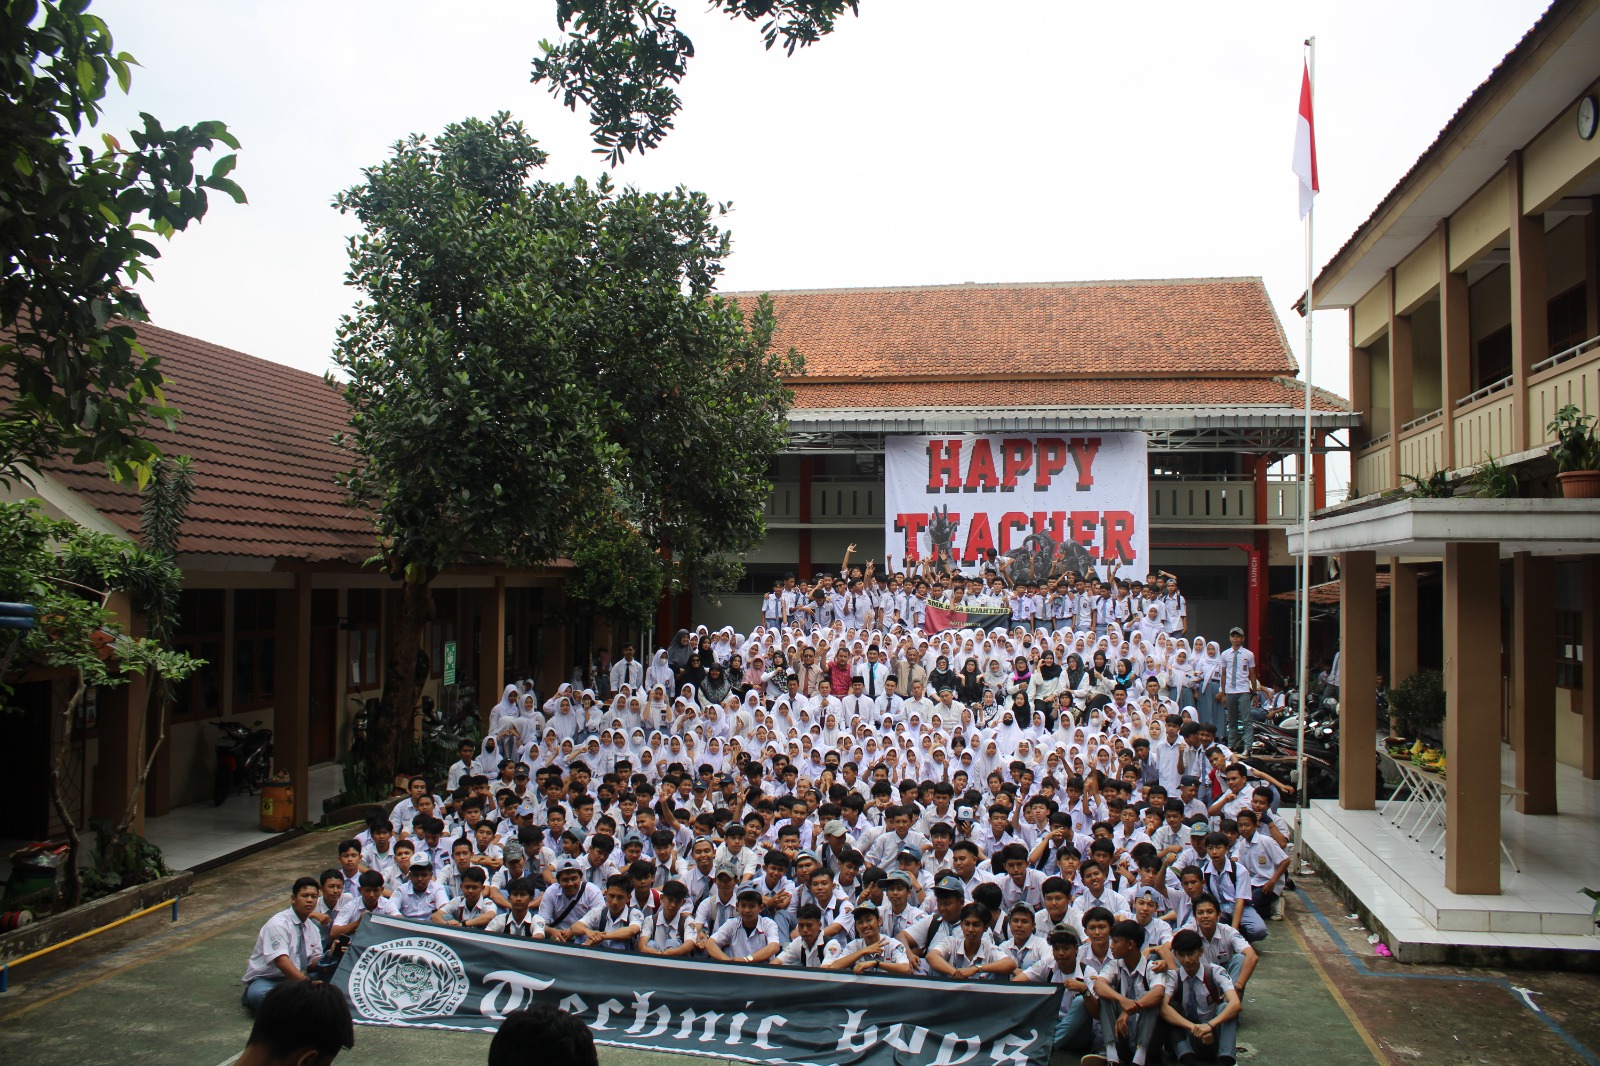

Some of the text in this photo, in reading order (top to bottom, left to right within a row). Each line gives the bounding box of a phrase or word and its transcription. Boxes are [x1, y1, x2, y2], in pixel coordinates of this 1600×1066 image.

[926, 437, 1102, 493] HAPPY
[927, 599, 944, 609] SMK
[359, 947, 379, 971] SMK
[418, 939, 465, 981] SEJAHTERA
